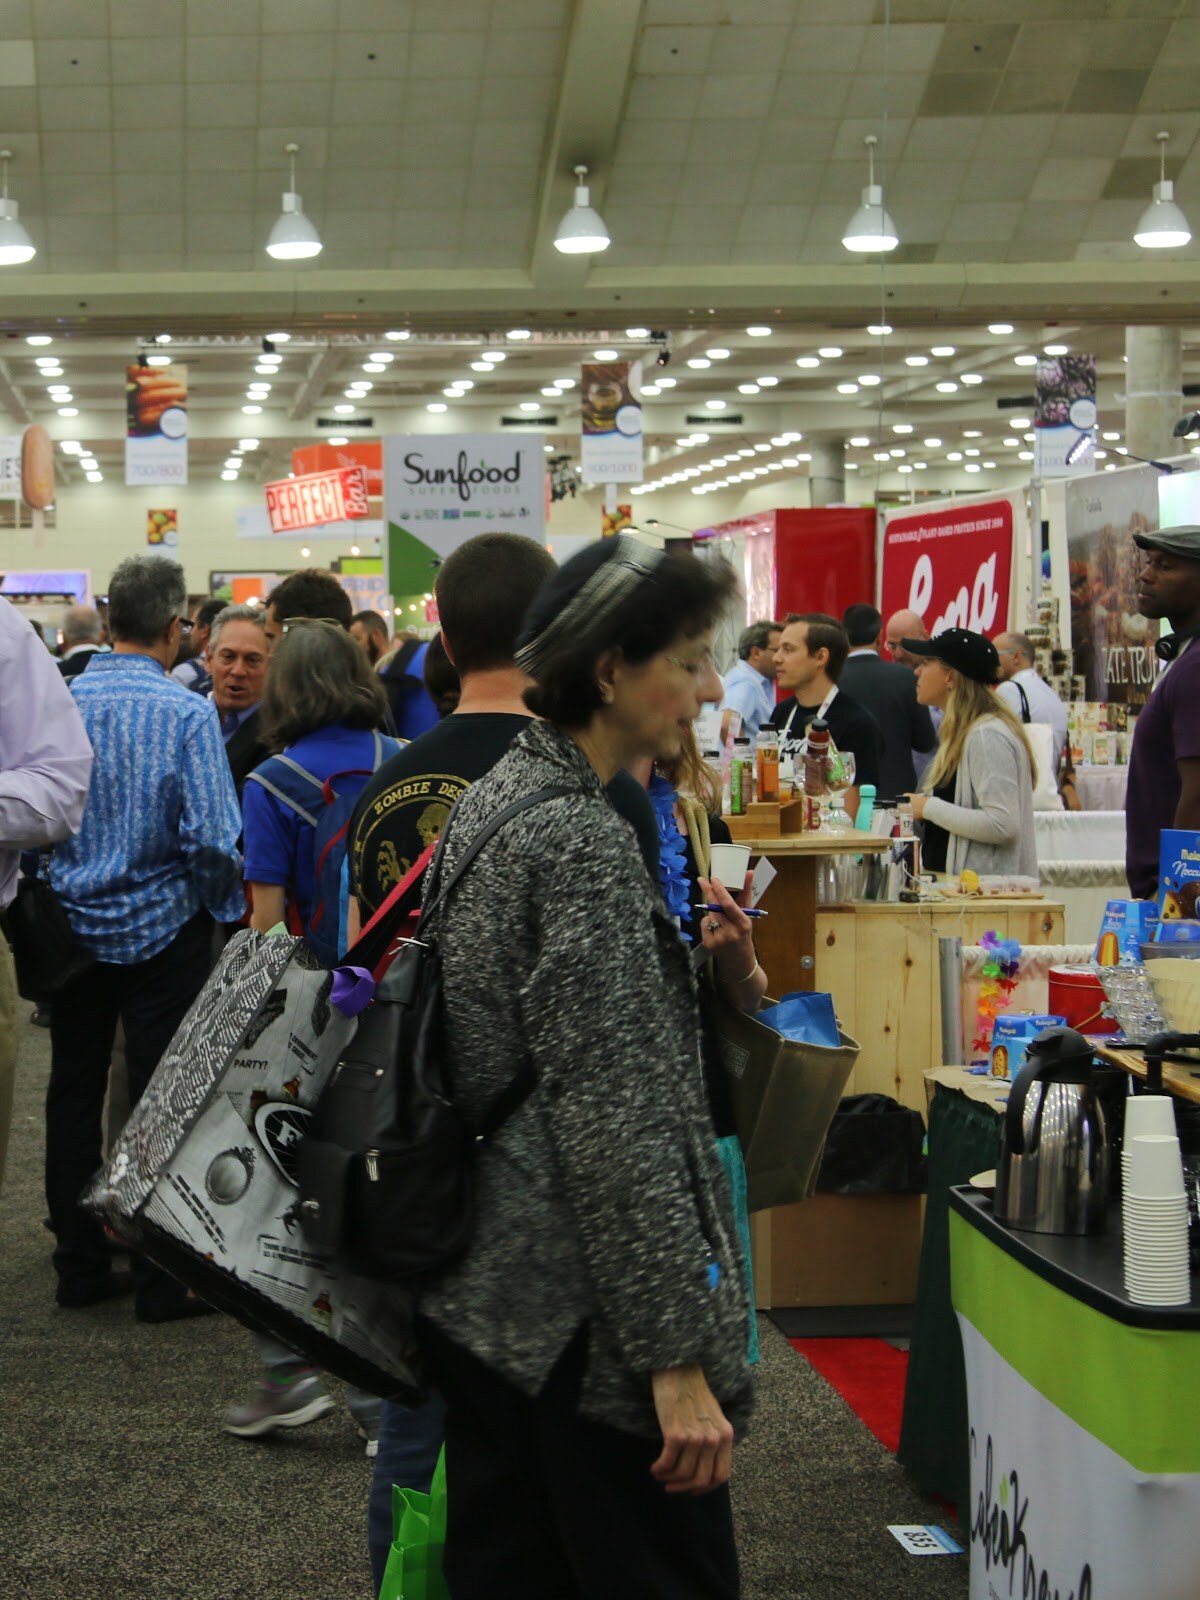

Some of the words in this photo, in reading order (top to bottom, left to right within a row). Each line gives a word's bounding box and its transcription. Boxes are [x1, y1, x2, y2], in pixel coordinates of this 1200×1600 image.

[403, 450, 521, 502] Sunfood
[265, 477, 343, 530] PERFECT
[344, 468, 368, 514] Bar
[408, 486, 457, 497] SUPER
[473, 485, 521, 495] FOODS
[374, 781, 432, 815] ZOMBIE
[234, 1059, 269, 1070] PARTY?
[903, 1531, 938, 1549] 855
